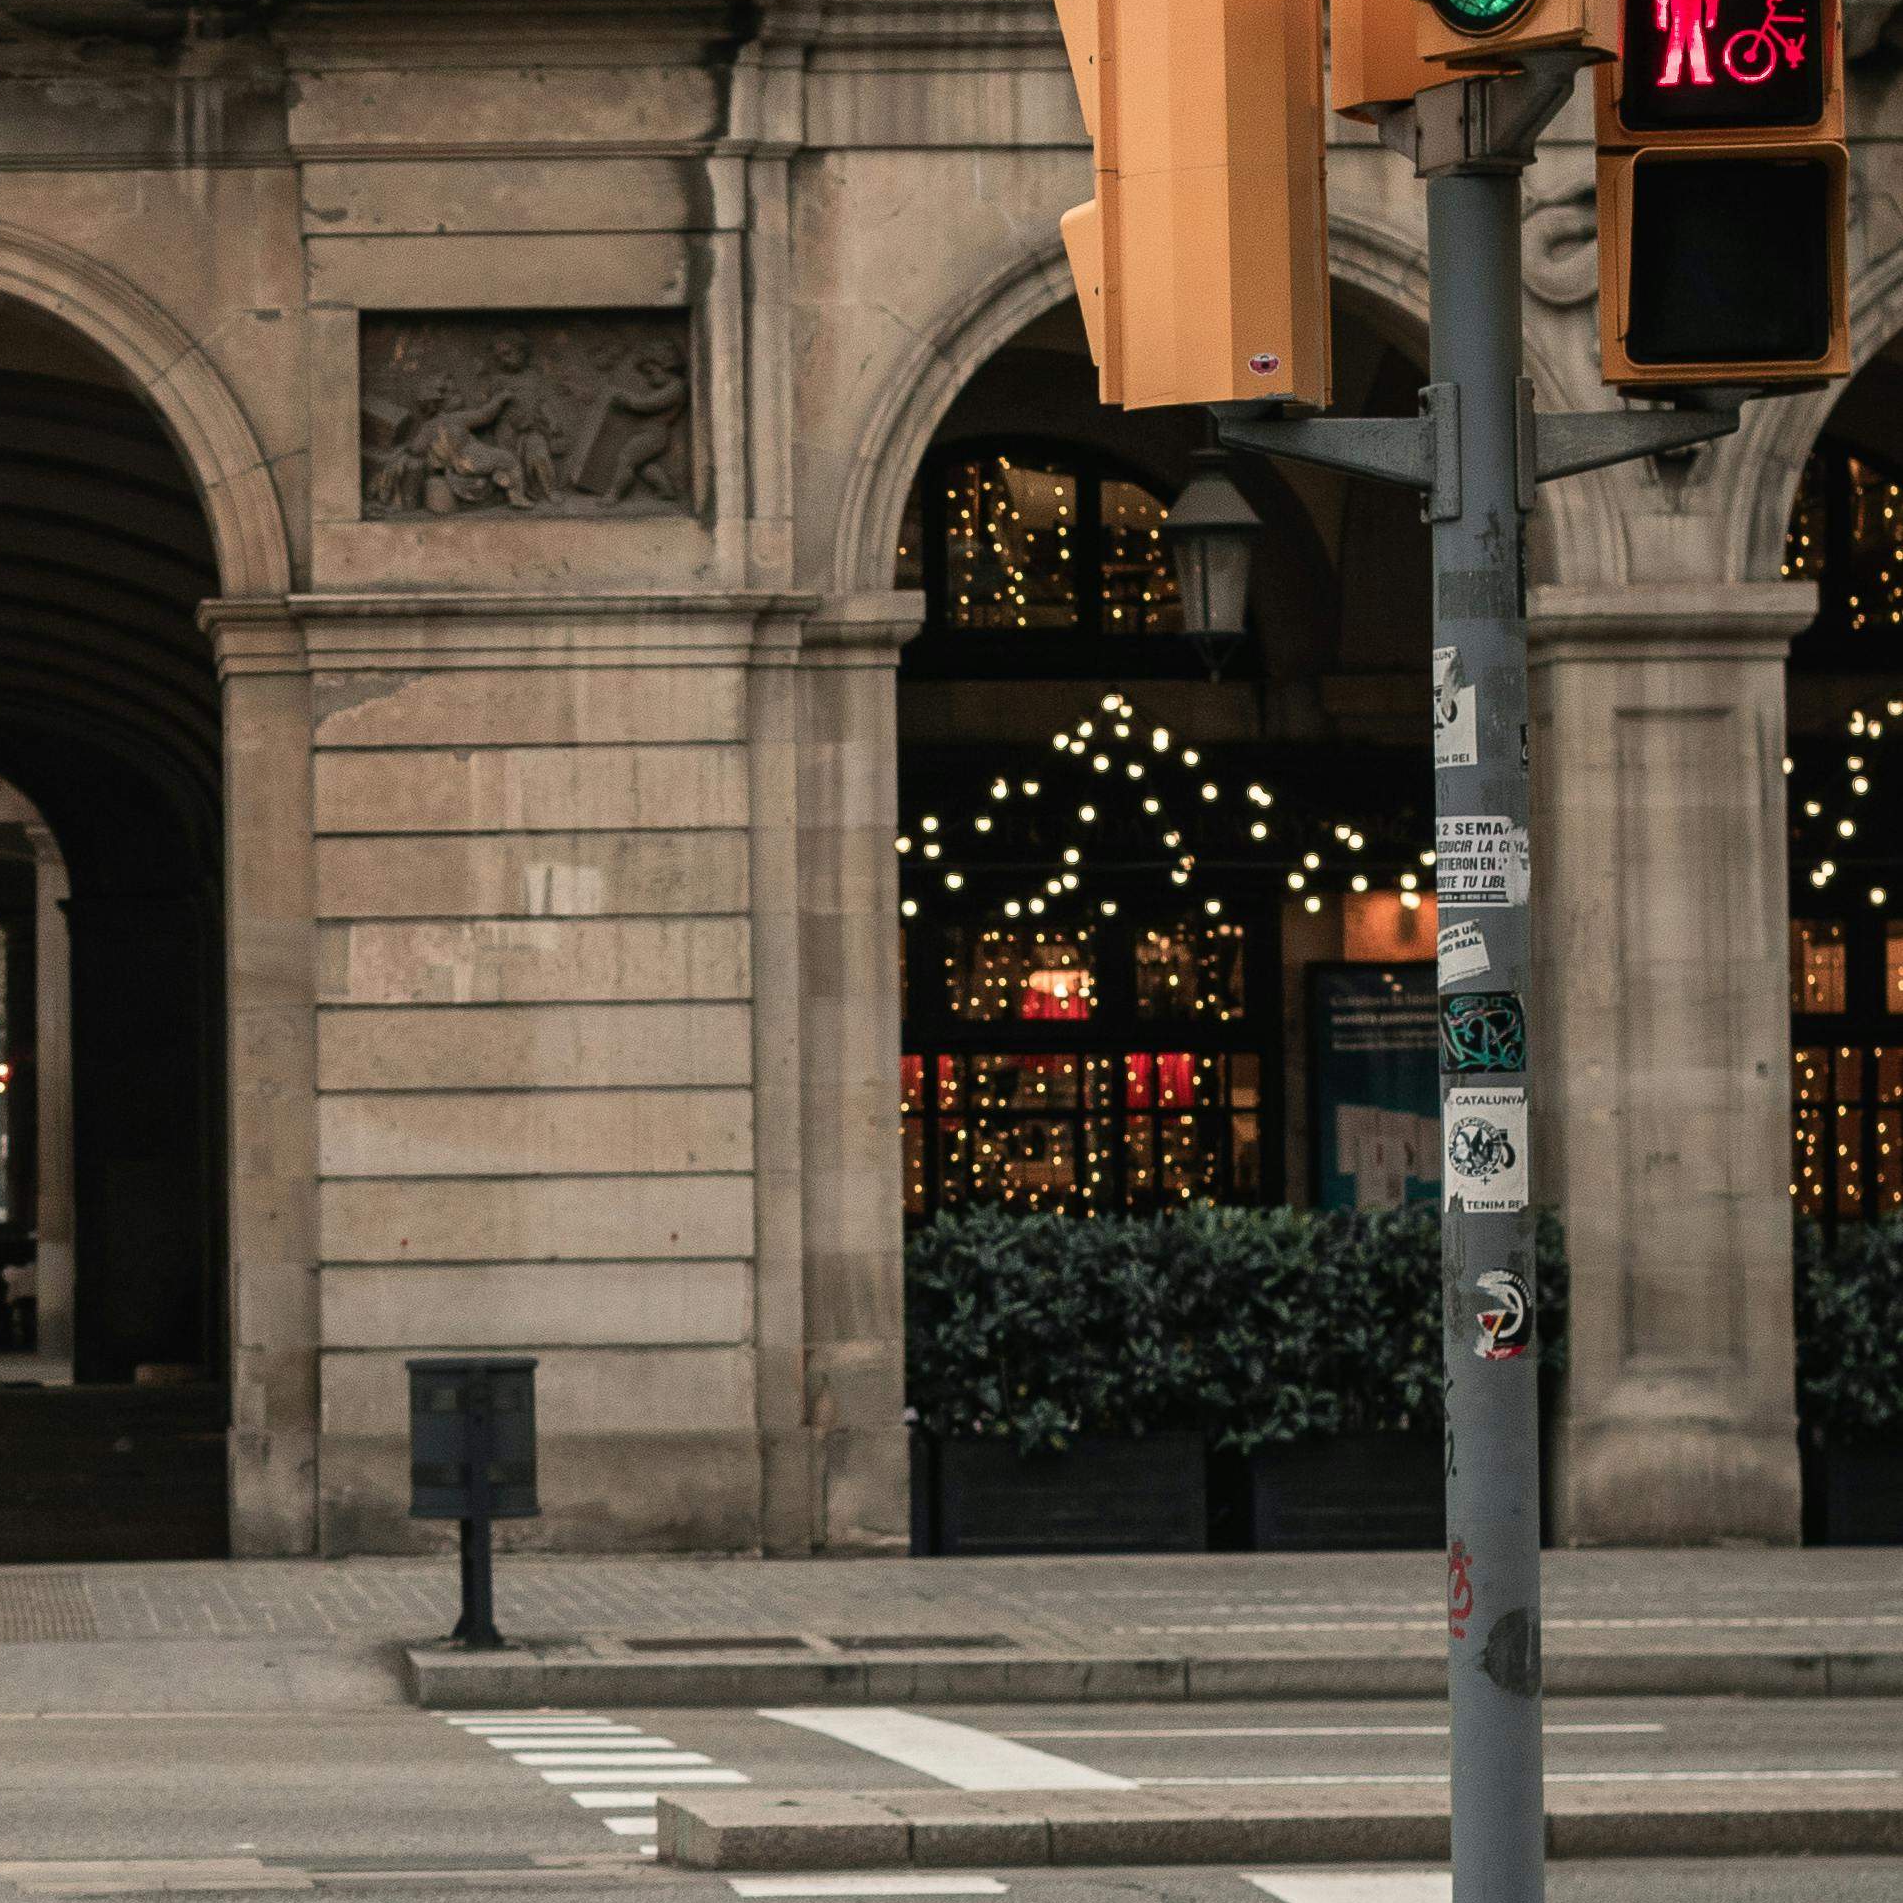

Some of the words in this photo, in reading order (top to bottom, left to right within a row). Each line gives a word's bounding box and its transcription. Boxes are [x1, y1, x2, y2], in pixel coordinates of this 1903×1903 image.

[1442, 823, 1449, 836] 2
[1438, 839, 1474, 854] EDUCIR
[1477, 840, 1493, 853] LA
[1481, 857, 1496, 870] EN
[1463, 875, 1478, 889] TU
[1455, 936, 1482, 950] REAL
[1456, 1096, 1526, 1106] CATALUNYA
[1466, 1200, 1505, 1210] TENIM
